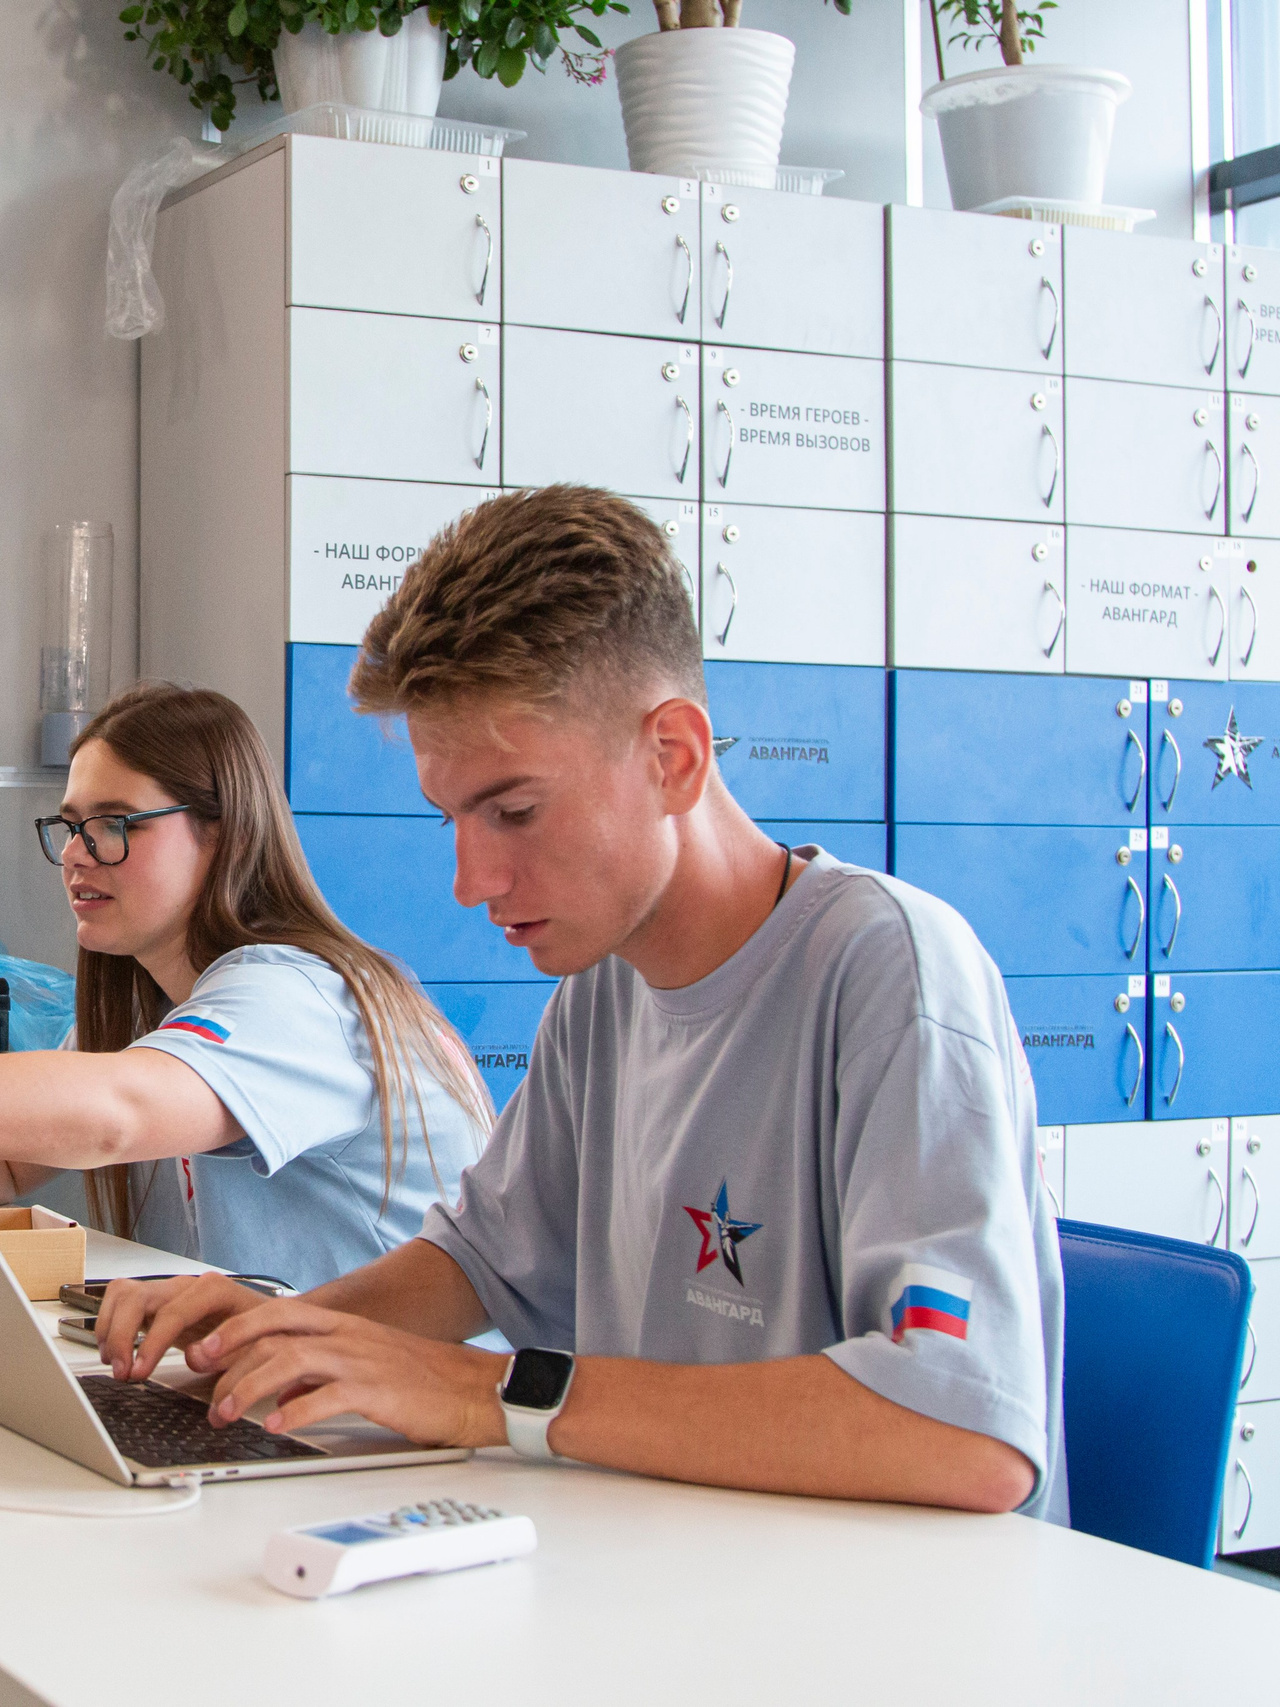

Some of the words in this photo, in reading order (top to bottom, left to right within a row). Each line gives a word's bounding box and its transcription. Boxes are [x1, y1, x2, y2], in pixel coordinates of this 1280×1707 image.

[686, 182, 691, 193] 2
[709, 185, 715, 196] 3
[485, 328, 491, 338] 7
[685, 348, 692, 358] 8
[710, 350, 717, 360] 9
[750, 402, 800, 421] ВРЕМЯ
[805, 408, 861, 426] ГЕРОЕВ
[739, 428, 791, 446] ВРЕМЯ
[795, 433, 871, 452] ВЫЗОВОВ
[684, 505, 694, 515] 14
[709, 507, 719, 517] 15
[325, 542, 370, 561] НАШ
[341, 572, 403, 592] АВАНГ
[1090, 578, 1125, 595] НАШ
[1129, 582, 1192, 600] ФОРМАТ
[1102, 606, 1178, 628] АВАНГАРД
[748, 745, 830, 764] АВАНГАРД
[1022, 1033, 1095, 1049] АВАНГАРД
[474, 1053, 529, 1070] НГАРД
[685, 1287, 765, 1329] АВАНГАРД
